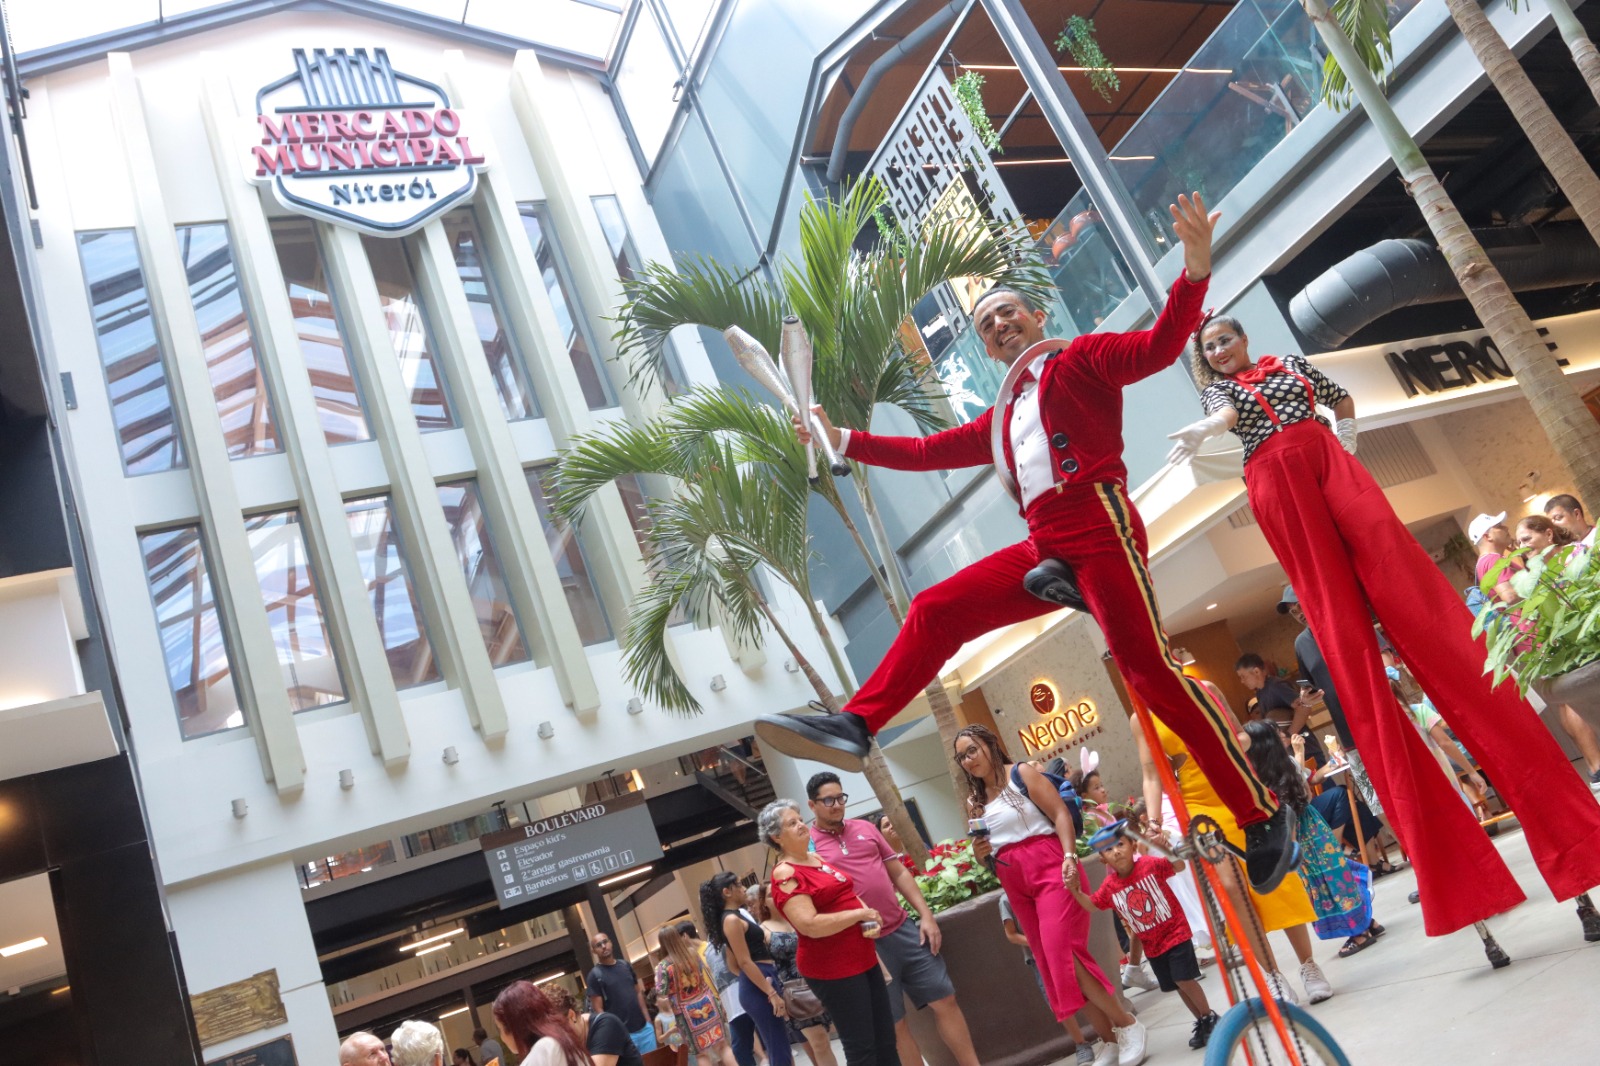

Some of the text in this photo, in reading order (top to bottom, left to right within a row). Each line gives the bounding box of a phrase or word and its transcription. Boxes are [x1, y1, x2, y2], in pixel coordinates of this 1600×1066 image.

[257, 109, 461, 145] MERCADO
[252, 137, 485, 176] MUNICIPAL
[329, 177, 437, 205] Niterói
[1384, 327, 1571, 399] NERO
[1018, 702, 1095, 756] Nerone
[525, 804, 606, 838] BOULEVARD
[514, 841, 545, 855] Espaço
[545, 833, 566, 845] kid's
[517, 850, 554, 867] Elevador
[558, 845, 610, 869] gastronomia
[525, 872, 569, 892] Banheiros
